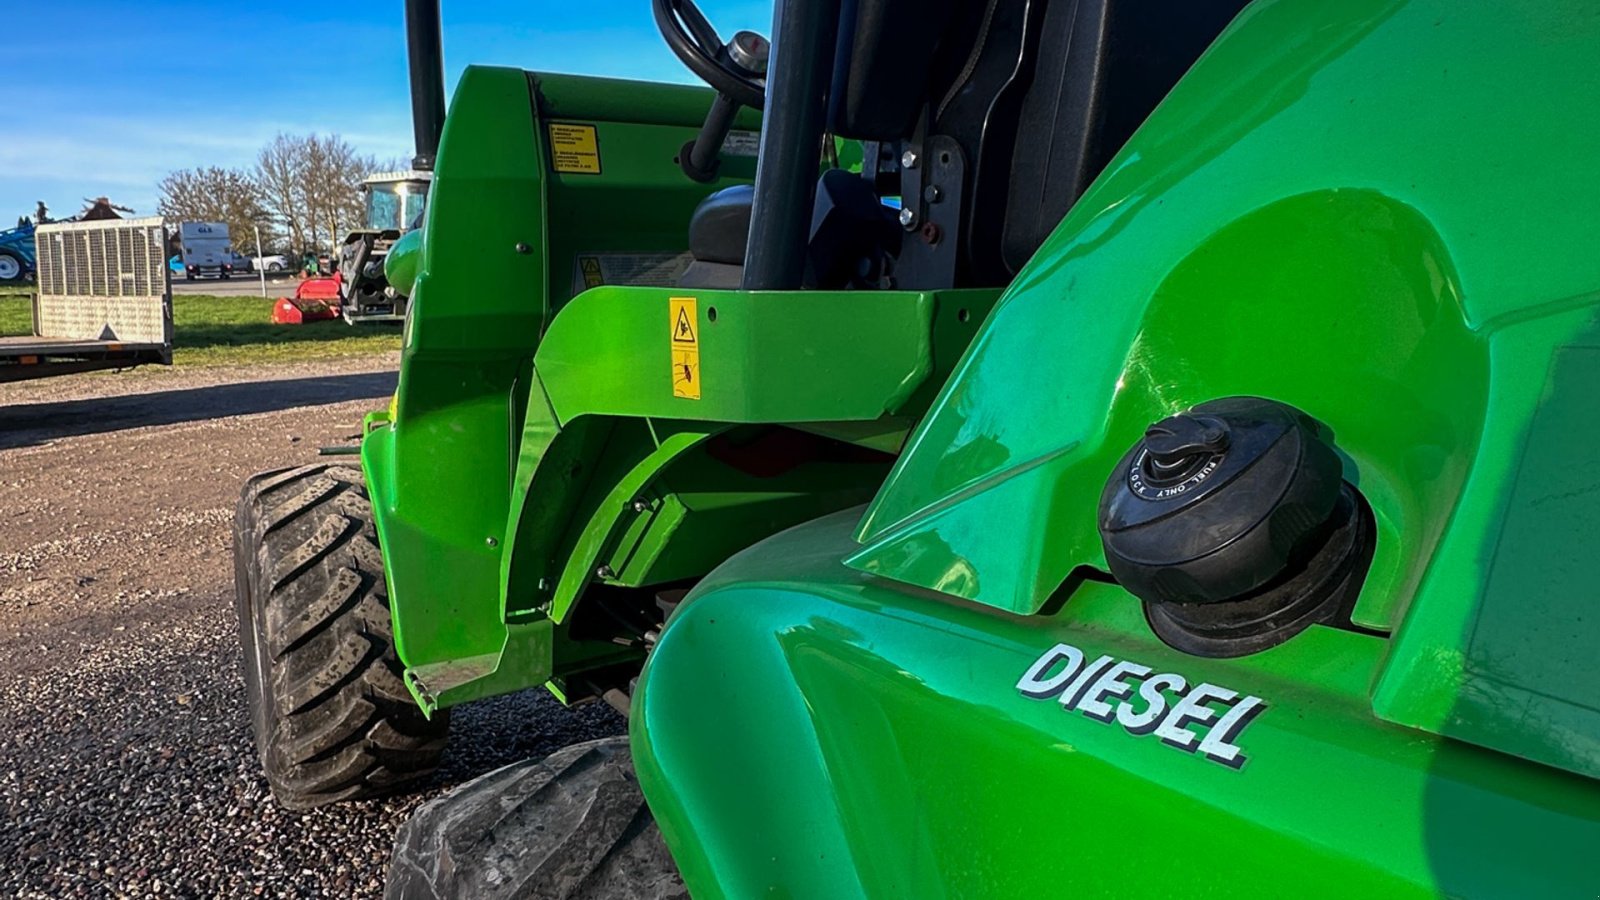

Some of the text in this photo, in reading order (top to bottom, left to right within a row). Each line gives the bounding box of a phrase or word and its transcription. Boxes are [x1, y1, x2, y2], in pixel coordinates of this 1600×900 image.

[1130, 467, 1147, 494] LOCK
[1156, 461, 1217, 498] FUEL ONLY
[1015, 642, 1268, 770] DIESEL
